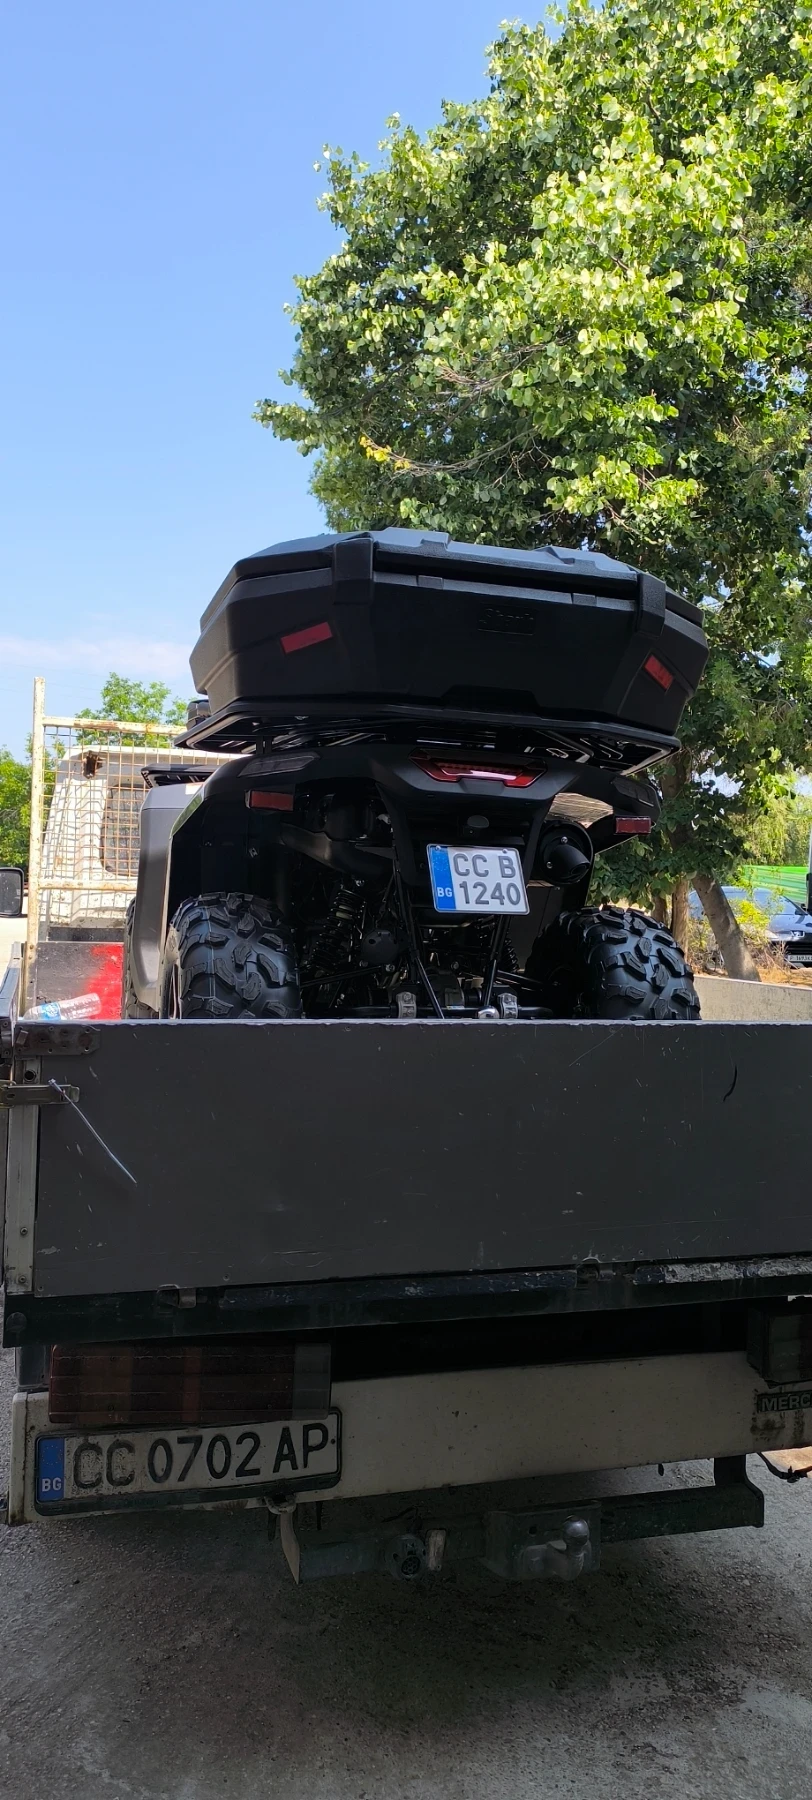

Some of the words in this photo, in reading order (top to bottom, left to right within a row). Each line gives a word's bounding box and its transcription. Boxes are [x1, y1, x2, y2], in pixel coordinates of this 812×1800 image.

[453, 853, 489, 877] CC
[498, 855, 516, 878] B
[437, 887, 453, 898] BG
[459, 881, 521, 905] 1240
[761, 1393, 811, 1412] MERC
[73, 1439, 135, 1489] CC
[147, 1430, 261, 1484] 0702
[272, 1422, 329, 1473] AP
[41, 1478, 62, 1493] BG
